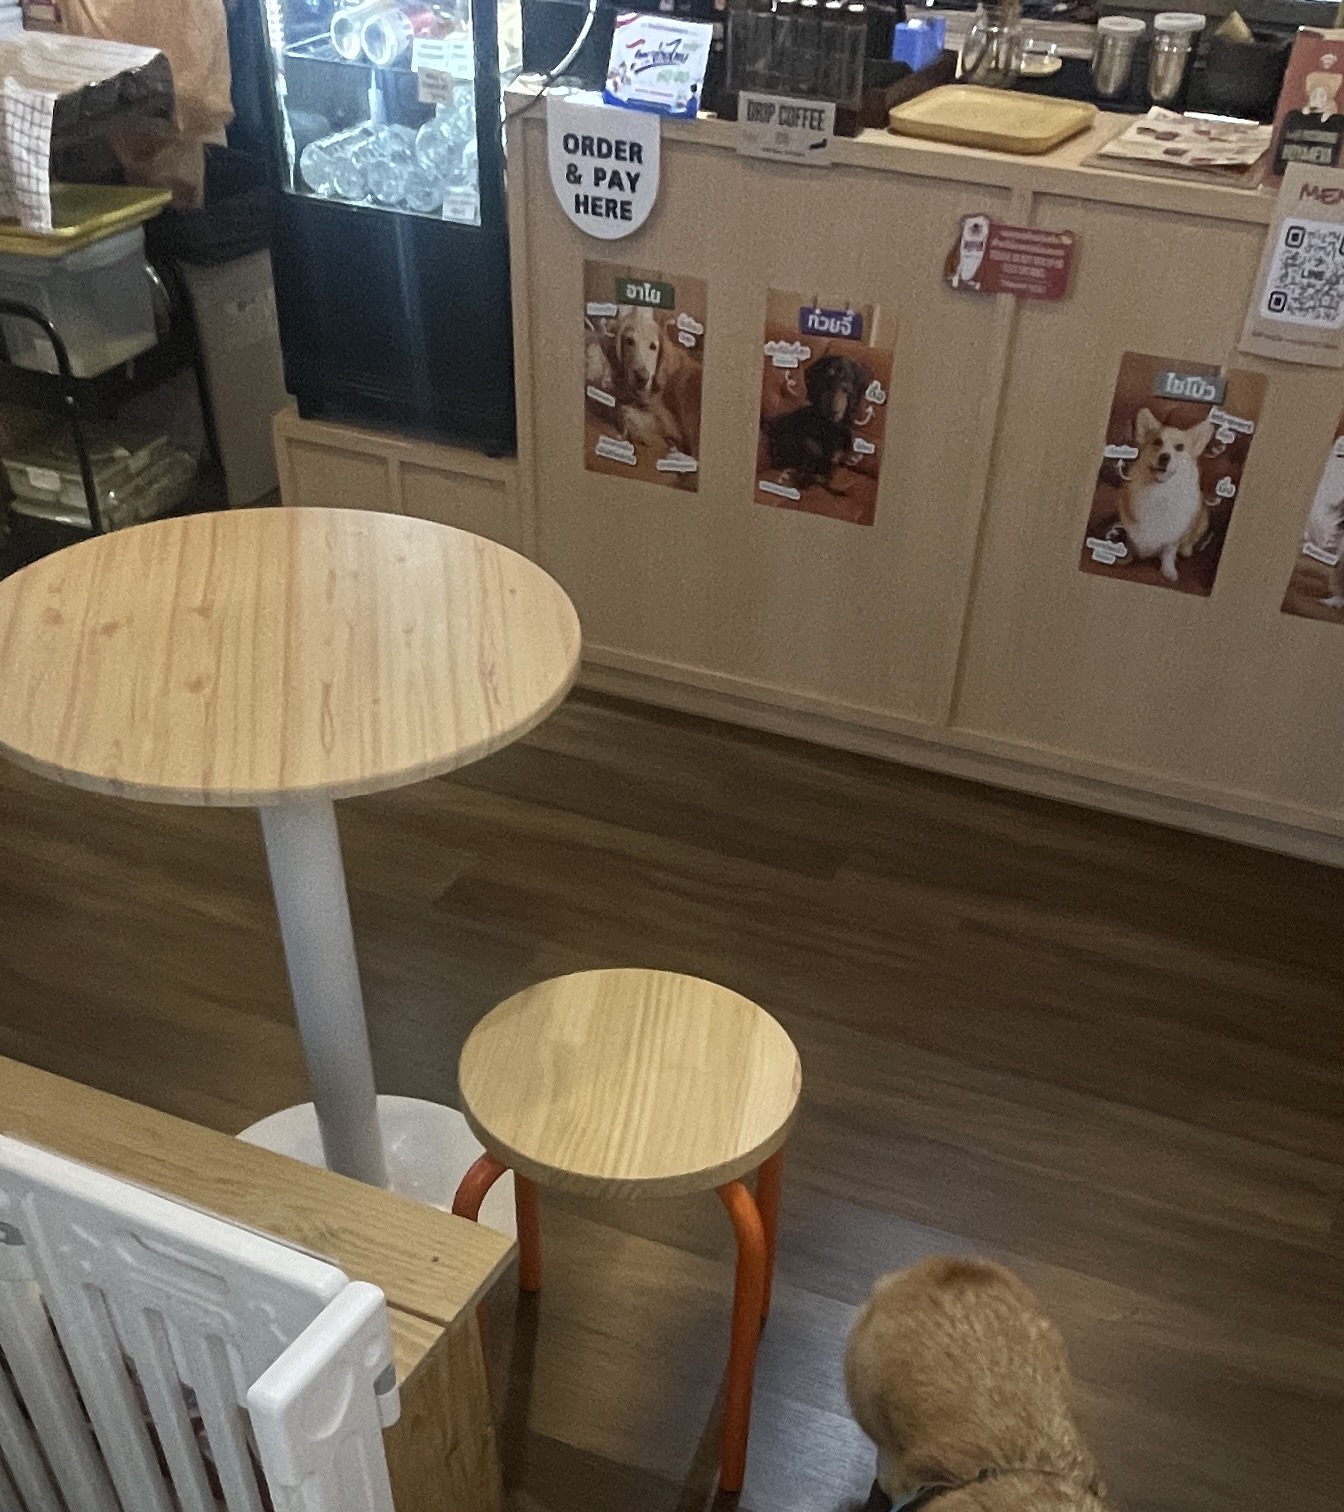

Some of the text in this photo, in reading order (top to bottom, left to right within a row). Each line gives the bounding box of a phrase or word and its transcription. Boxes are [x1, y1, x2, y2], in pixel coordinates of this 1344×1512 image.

[778, 104, 826, 132] COFFEE
[563, 132, 644, 165] ORDER
[566, 165, 641, 194] & PAY
[574, 193, 634, 222] HERE
